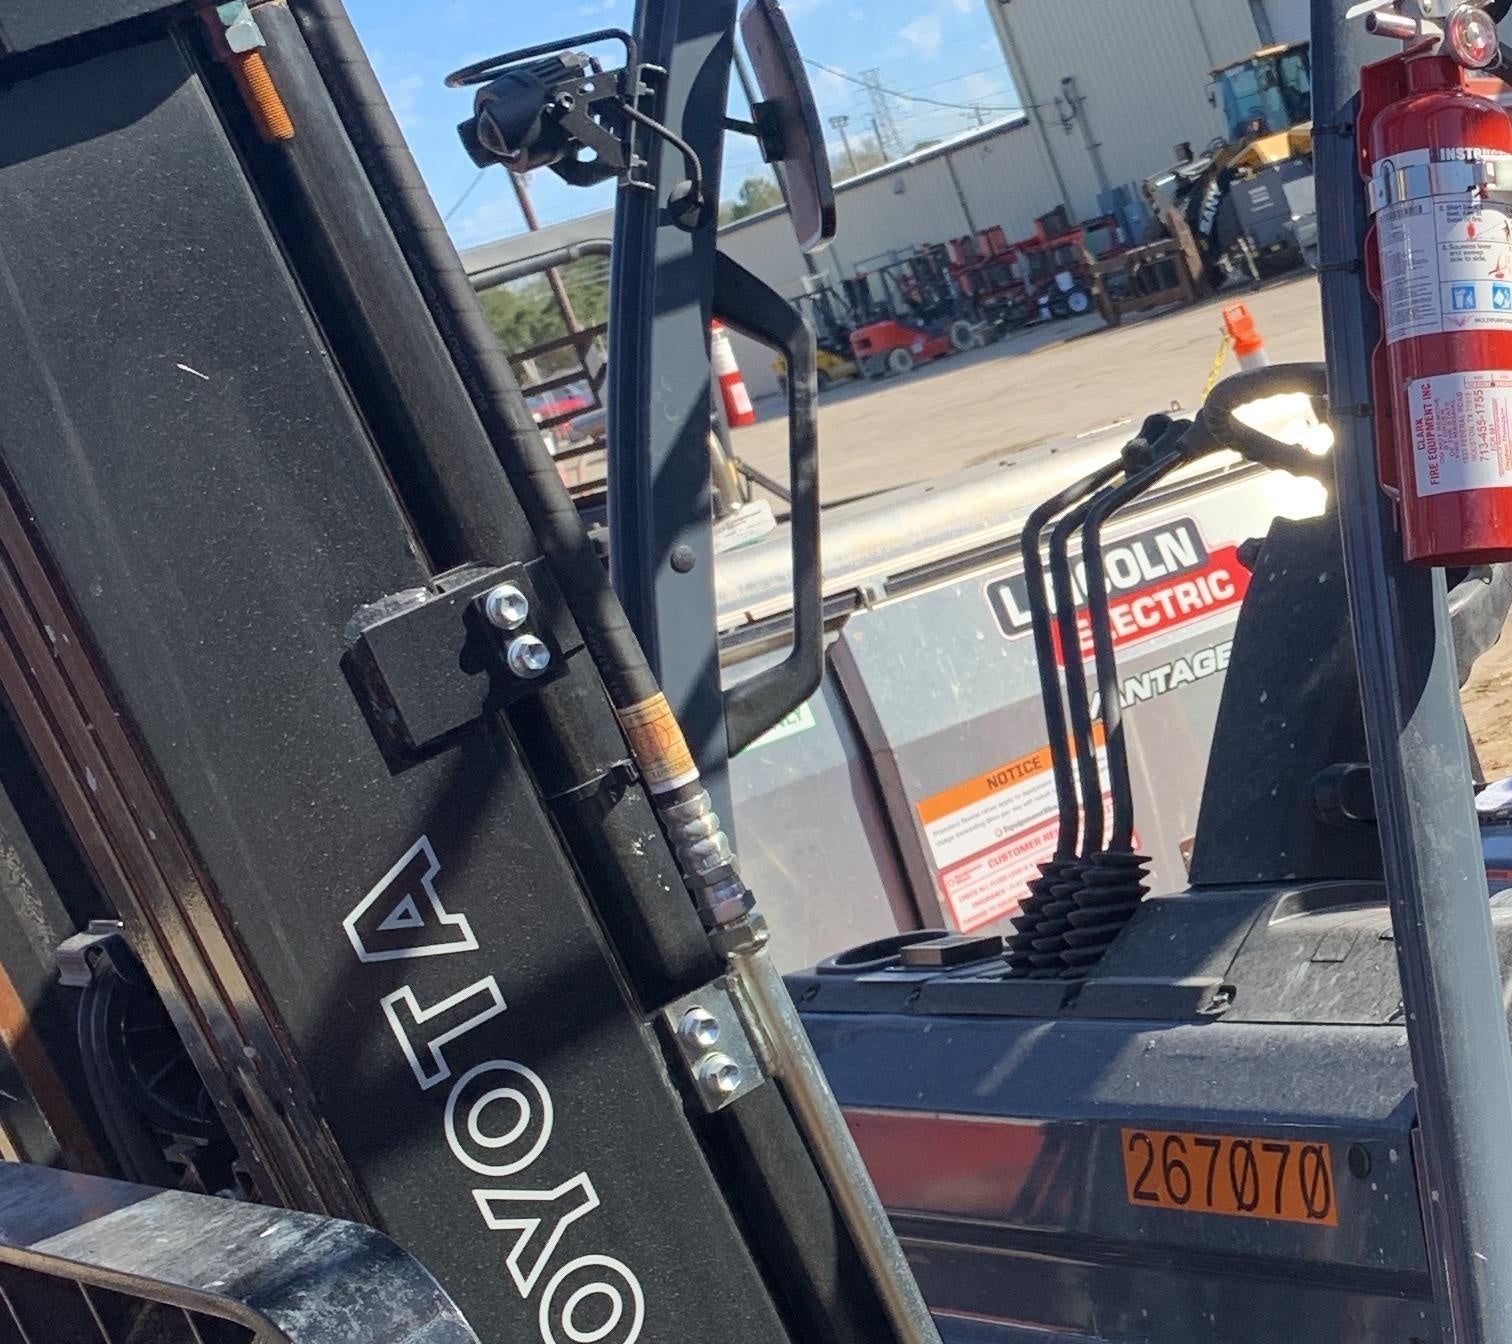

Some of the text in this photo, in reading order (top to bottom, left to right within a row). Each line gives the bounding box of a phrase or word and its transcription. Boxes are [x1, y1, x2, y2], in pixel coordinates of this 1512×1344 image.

[1415, 417, 1426, 451] CLARK
[1424, 403, 1439, 461] EQUIPMENT
[1428, 462, 1440, 486] FIRE
[1076, 570, 1235, 651] EECTRIC
[986, 755, 1043, 790] NOTICE
[986, 838, 1040, 869] CUSTOMER
[1127, 1130, 1333, 1219] 267070
